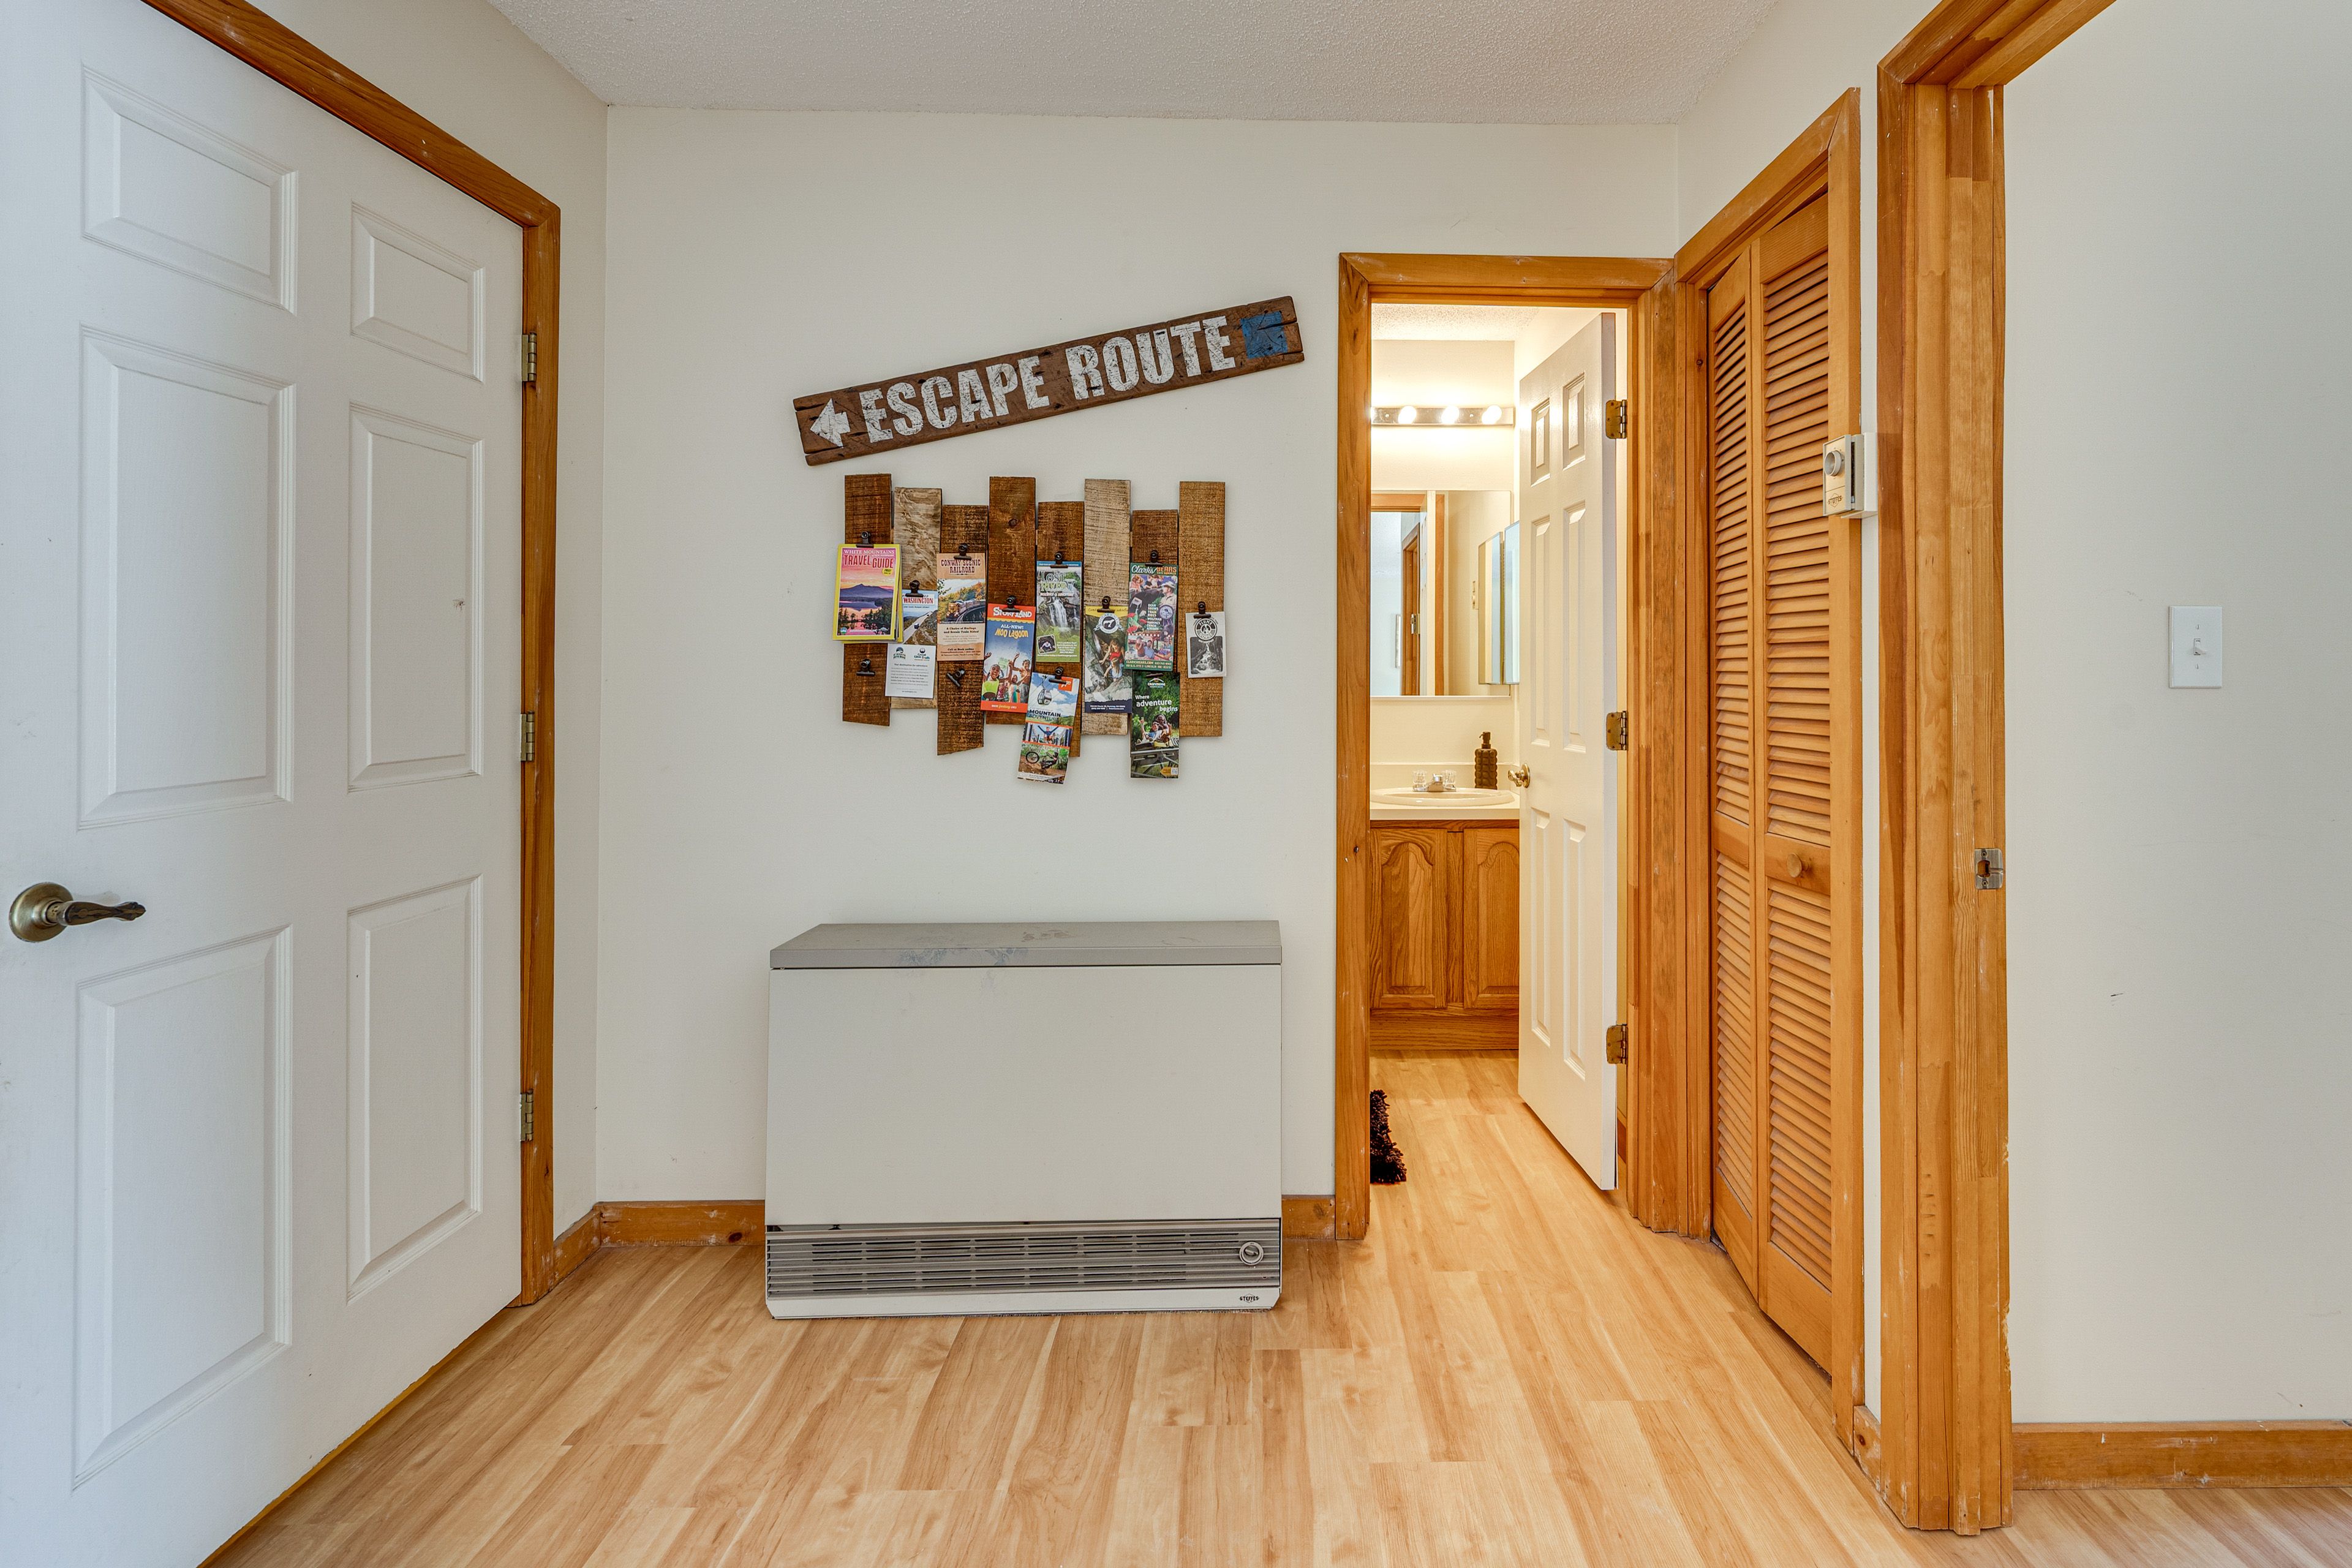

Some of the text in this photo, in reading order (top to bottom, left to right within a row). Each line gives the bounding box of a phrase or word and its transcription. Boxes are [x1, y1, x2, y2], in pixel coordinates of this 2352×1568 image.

[859, 315, 1237, 443] ESCAPE ROUTE
[844, 555, 894, 568] TRAVEL GUIDE
[1131, 565, 1157, 574] Clark's
[1041, 571, 1066, 582] LOST
[1008, 629, 1029, 639] Lagoon
